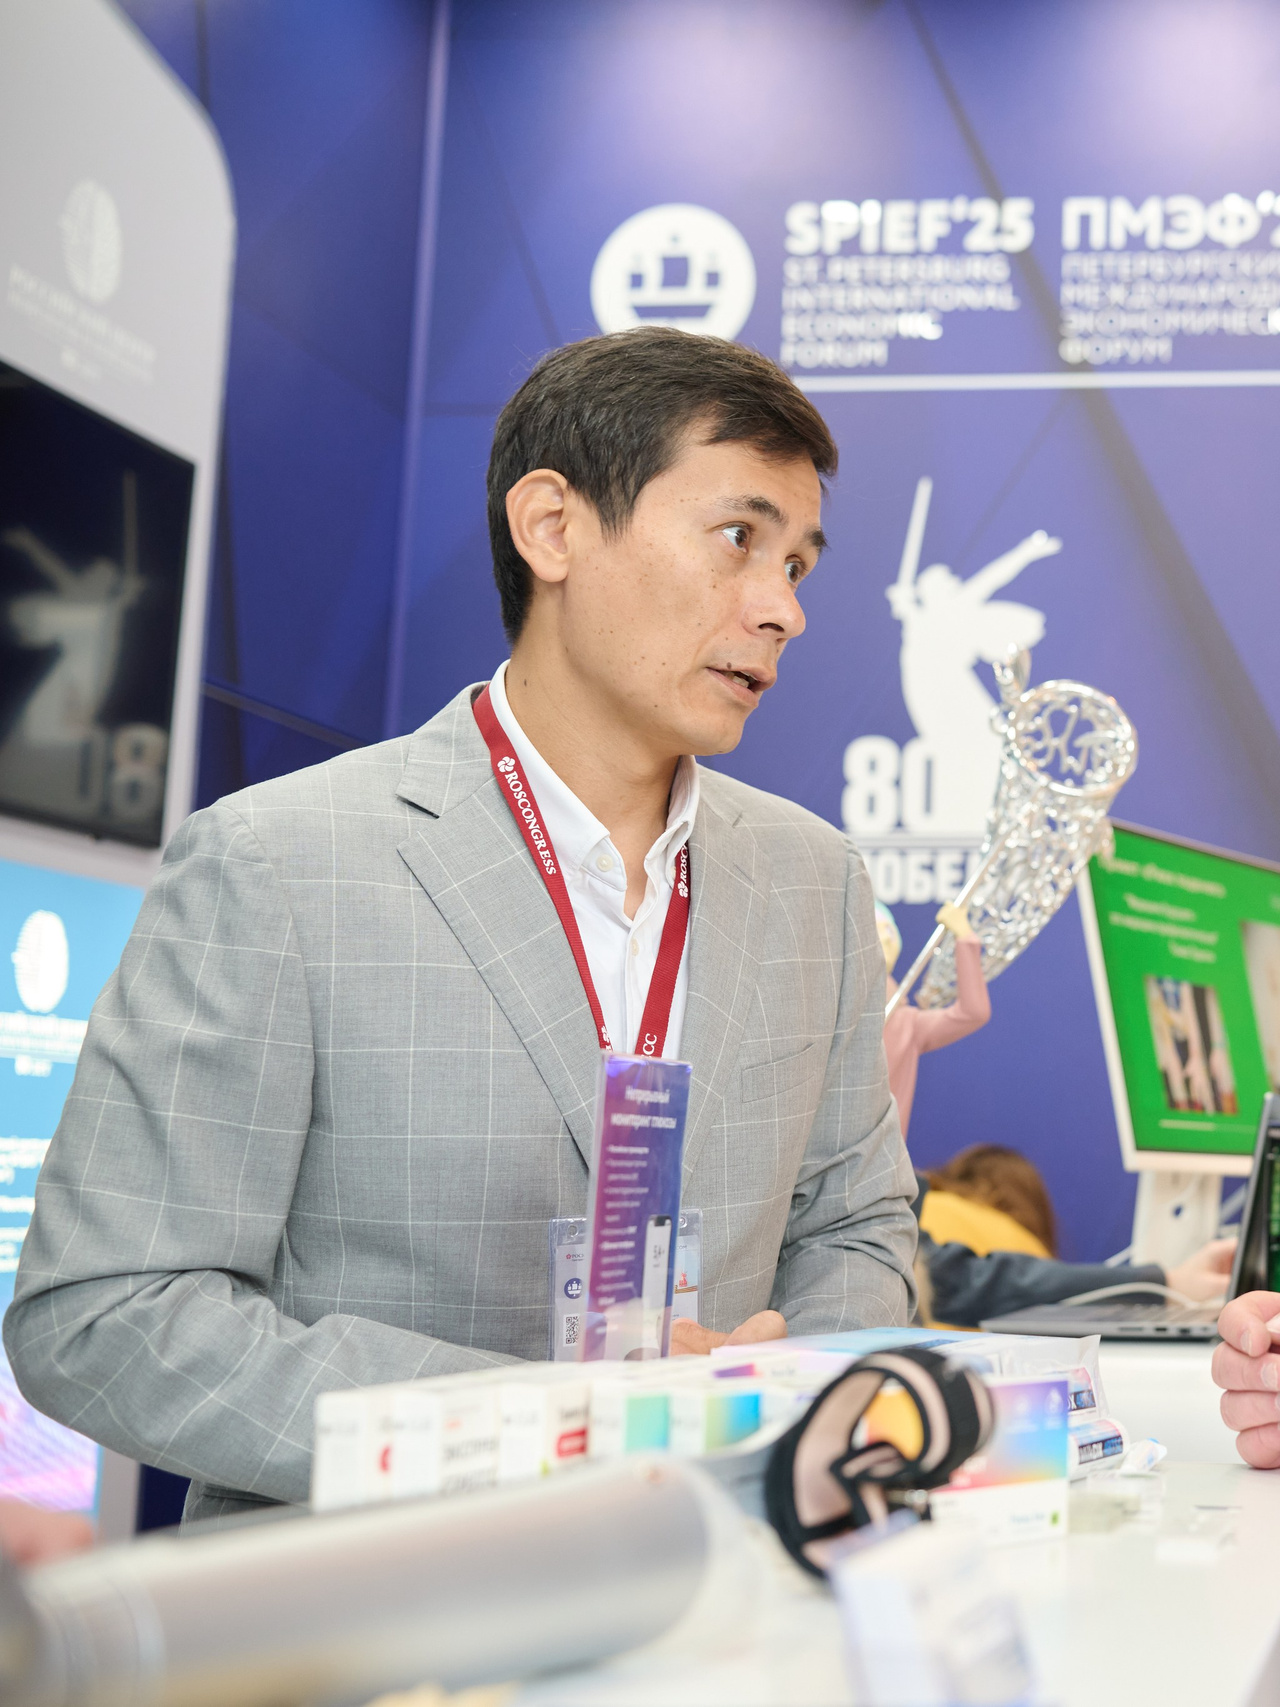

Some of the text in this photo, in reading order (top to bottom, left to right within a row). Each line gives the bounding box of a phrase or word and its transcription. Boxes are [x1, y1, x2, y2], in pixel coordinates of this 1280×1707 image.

[784, 196, 1035, 256] SPIEF'25
[781, 282, 1020, 312] INTERNATIONAL
[780, 309, 943, 340] ECONOMIC
[780, 339, 888, 368] FORUM
[841, 735, 956, 834] 80
[505, 770, 557, 875] ROSCONGRESS
[680, 844, 689, 884] ROSC
